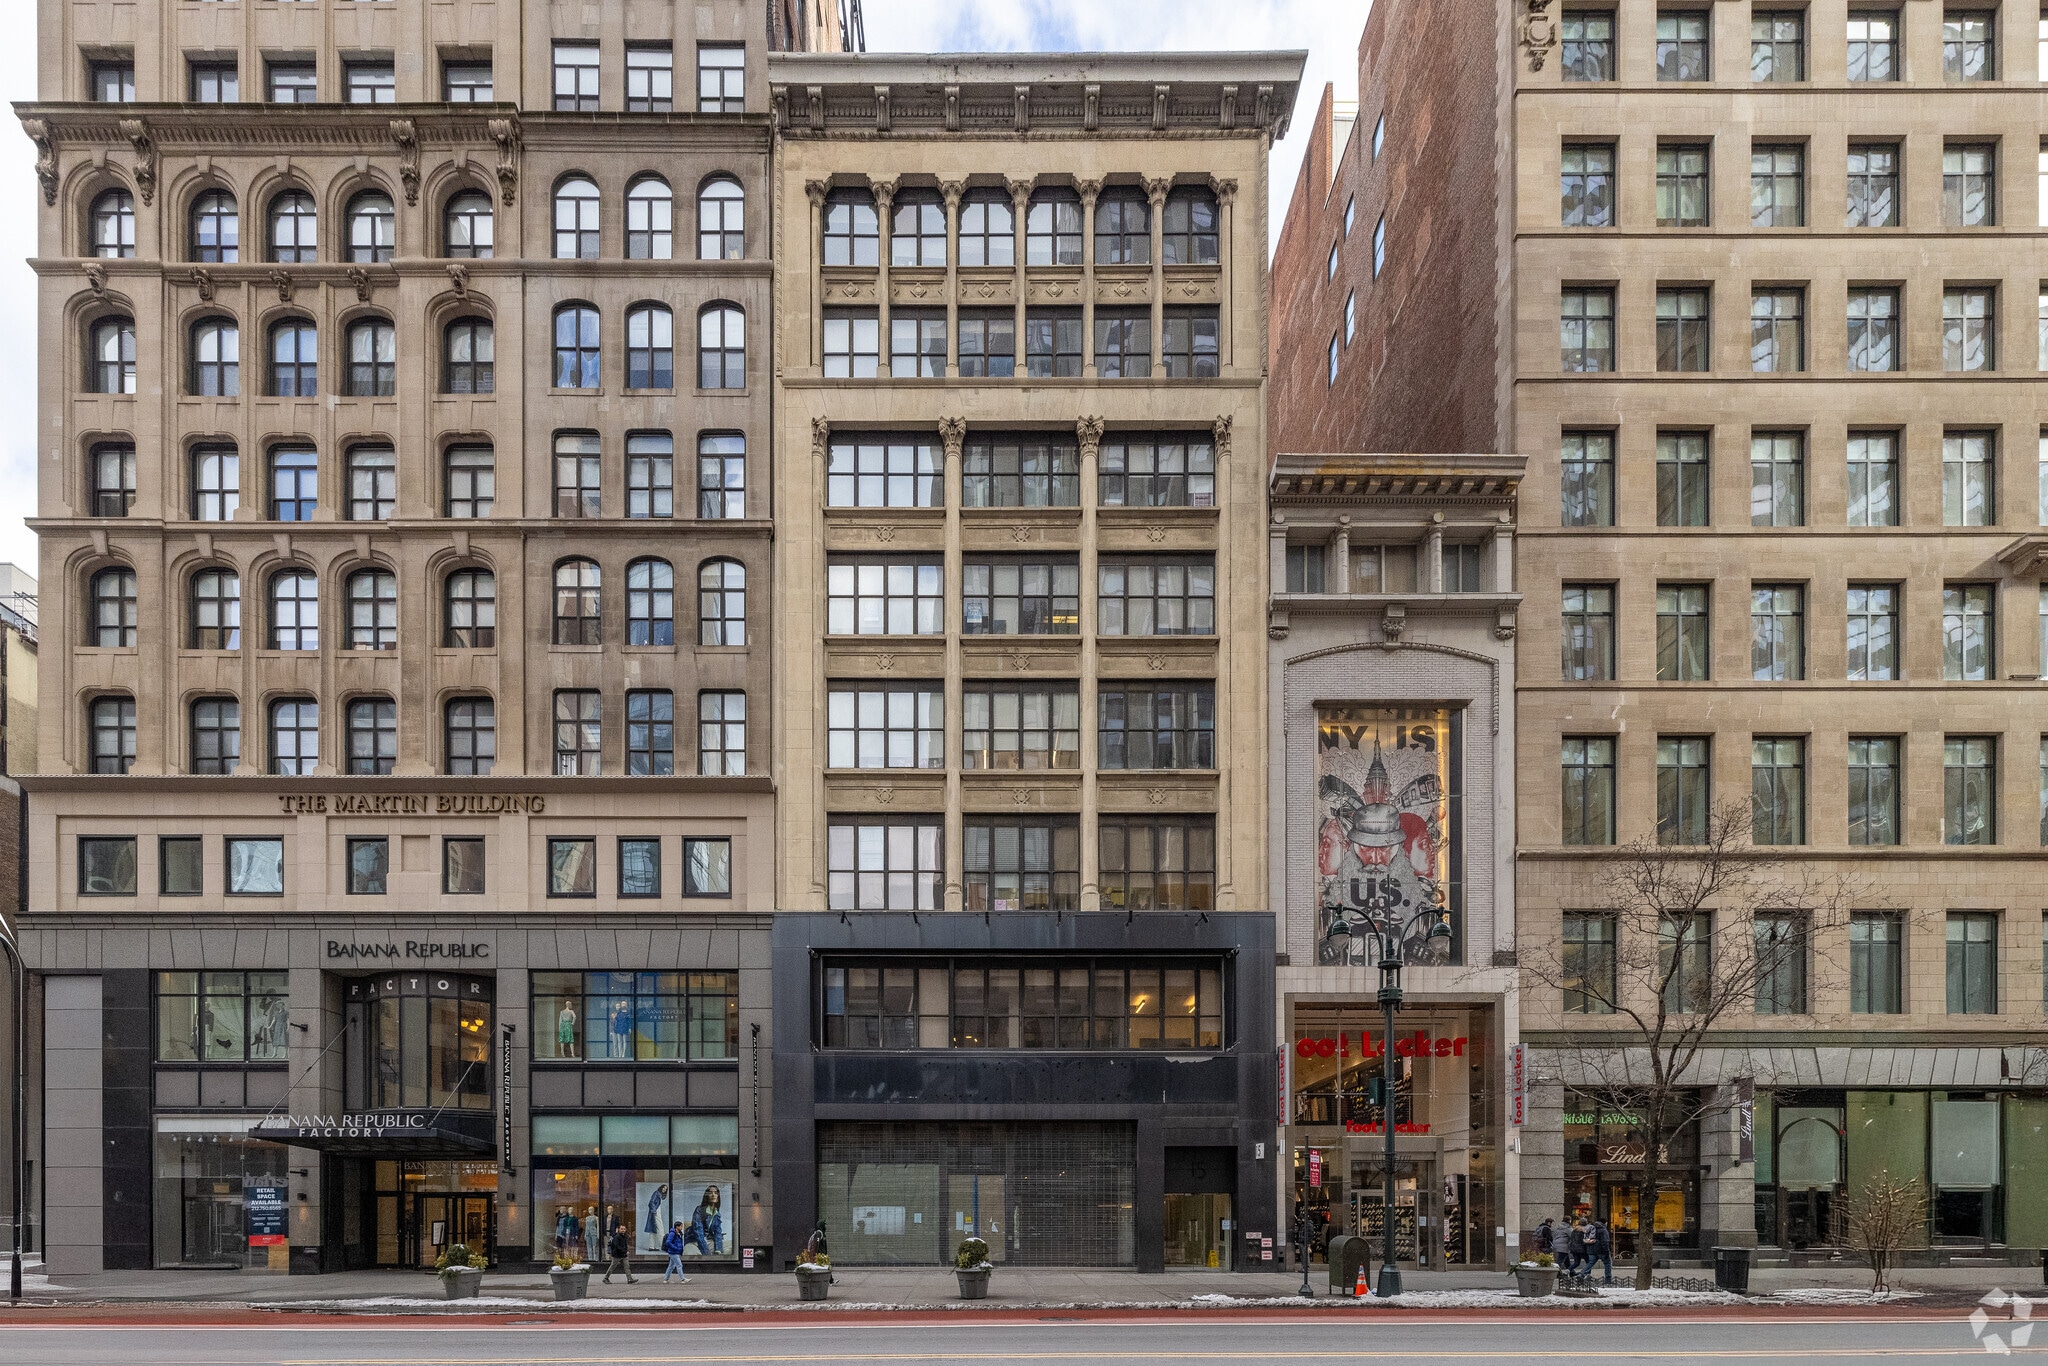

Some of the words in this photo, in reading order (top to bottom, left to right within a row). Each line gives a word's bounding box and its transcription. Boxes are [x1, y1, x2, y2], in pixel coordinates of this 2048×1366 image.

[1318, 725, 1368, 754] NY
[1397, 725, 1435, 752] IS
[279, 794, 327, 813] THE
[334, 794, 428, 813] MARTIN
[435, 794, 545, 813] BUILDING
[327, 940, 400, 958] BANANA
[406, 940, 489, 958] REPUBLIC
[352, 979, 480, 995] FACTOR
[1295, 1033, 1349, 1058] oot
[1362, 1030, 1467, 1058] Locker
[1514, 1048, 1522, 1091] Locker
[1514, 1095, 1522, 1124] Foot
[265, 1115, 336, 1127] BANANA
[342, 1115, 424, 1127] REPUBLIC
[1346, 1120, 1378, 1133] Foot
[1741, 1108, 1751, 1141] Lindt
[299, 1128, 384, 1137] FACTORY
[1601, 1145, 1650, 1163] Lind
